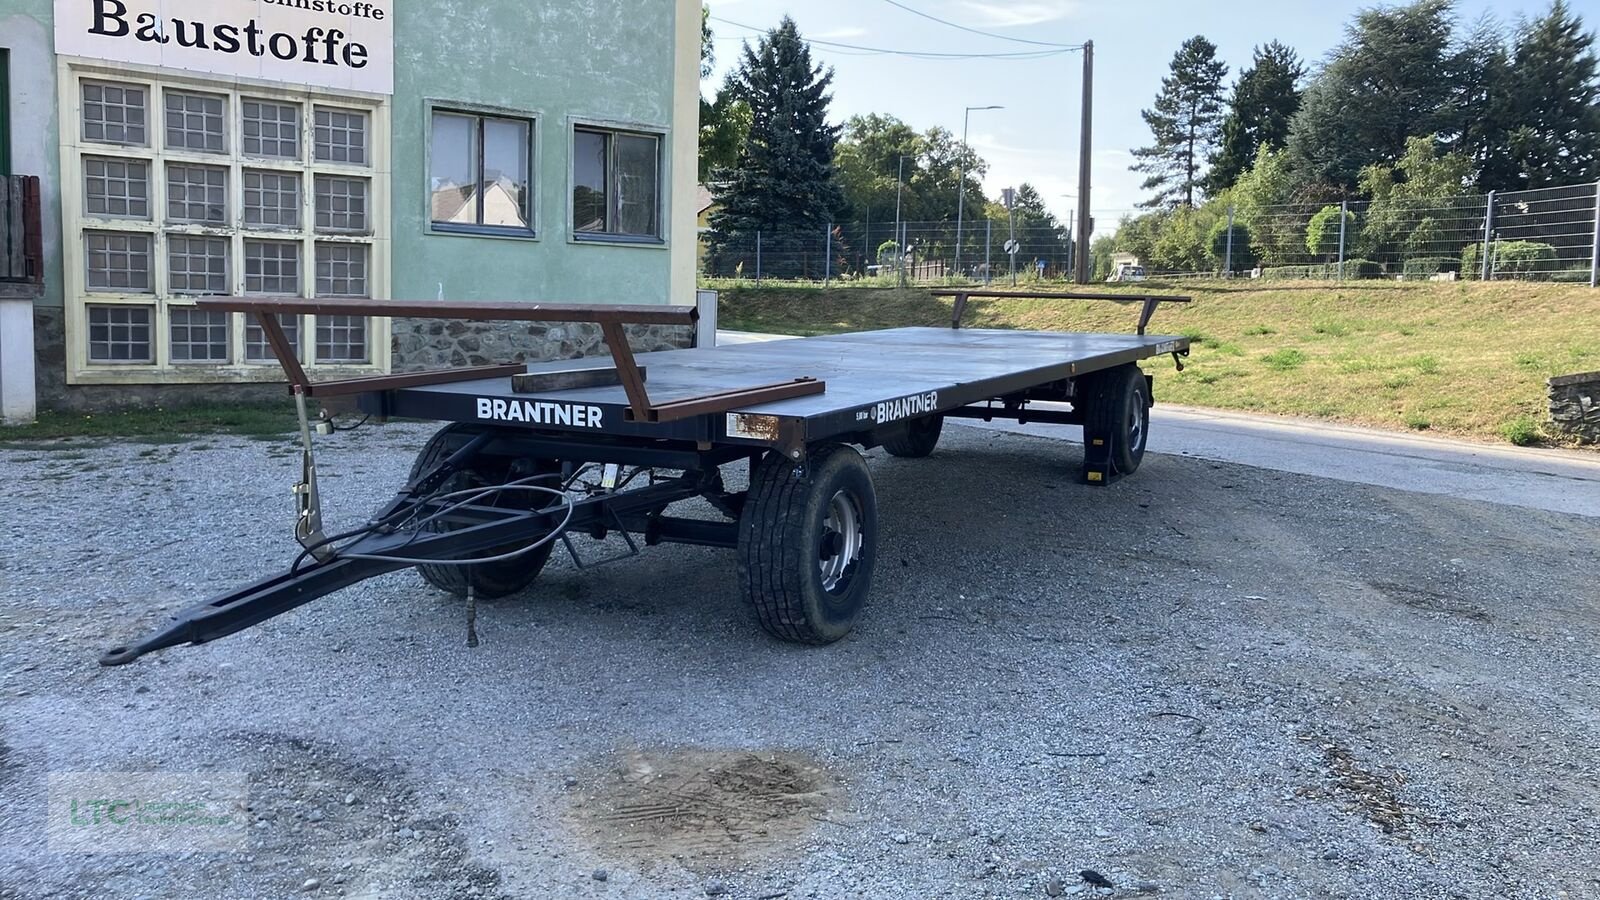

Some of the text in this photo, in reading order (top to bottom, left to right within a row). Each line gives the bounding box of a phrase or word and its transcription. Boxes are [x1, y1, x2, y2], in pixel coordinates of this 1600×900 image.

[250, 0, 384, 20] nnstoffe
[88, 0, 368, 68] Baustoffe
[477, 398, 603, 428] BRANTNER
[877, 391, 938, 424] BRANTNER
